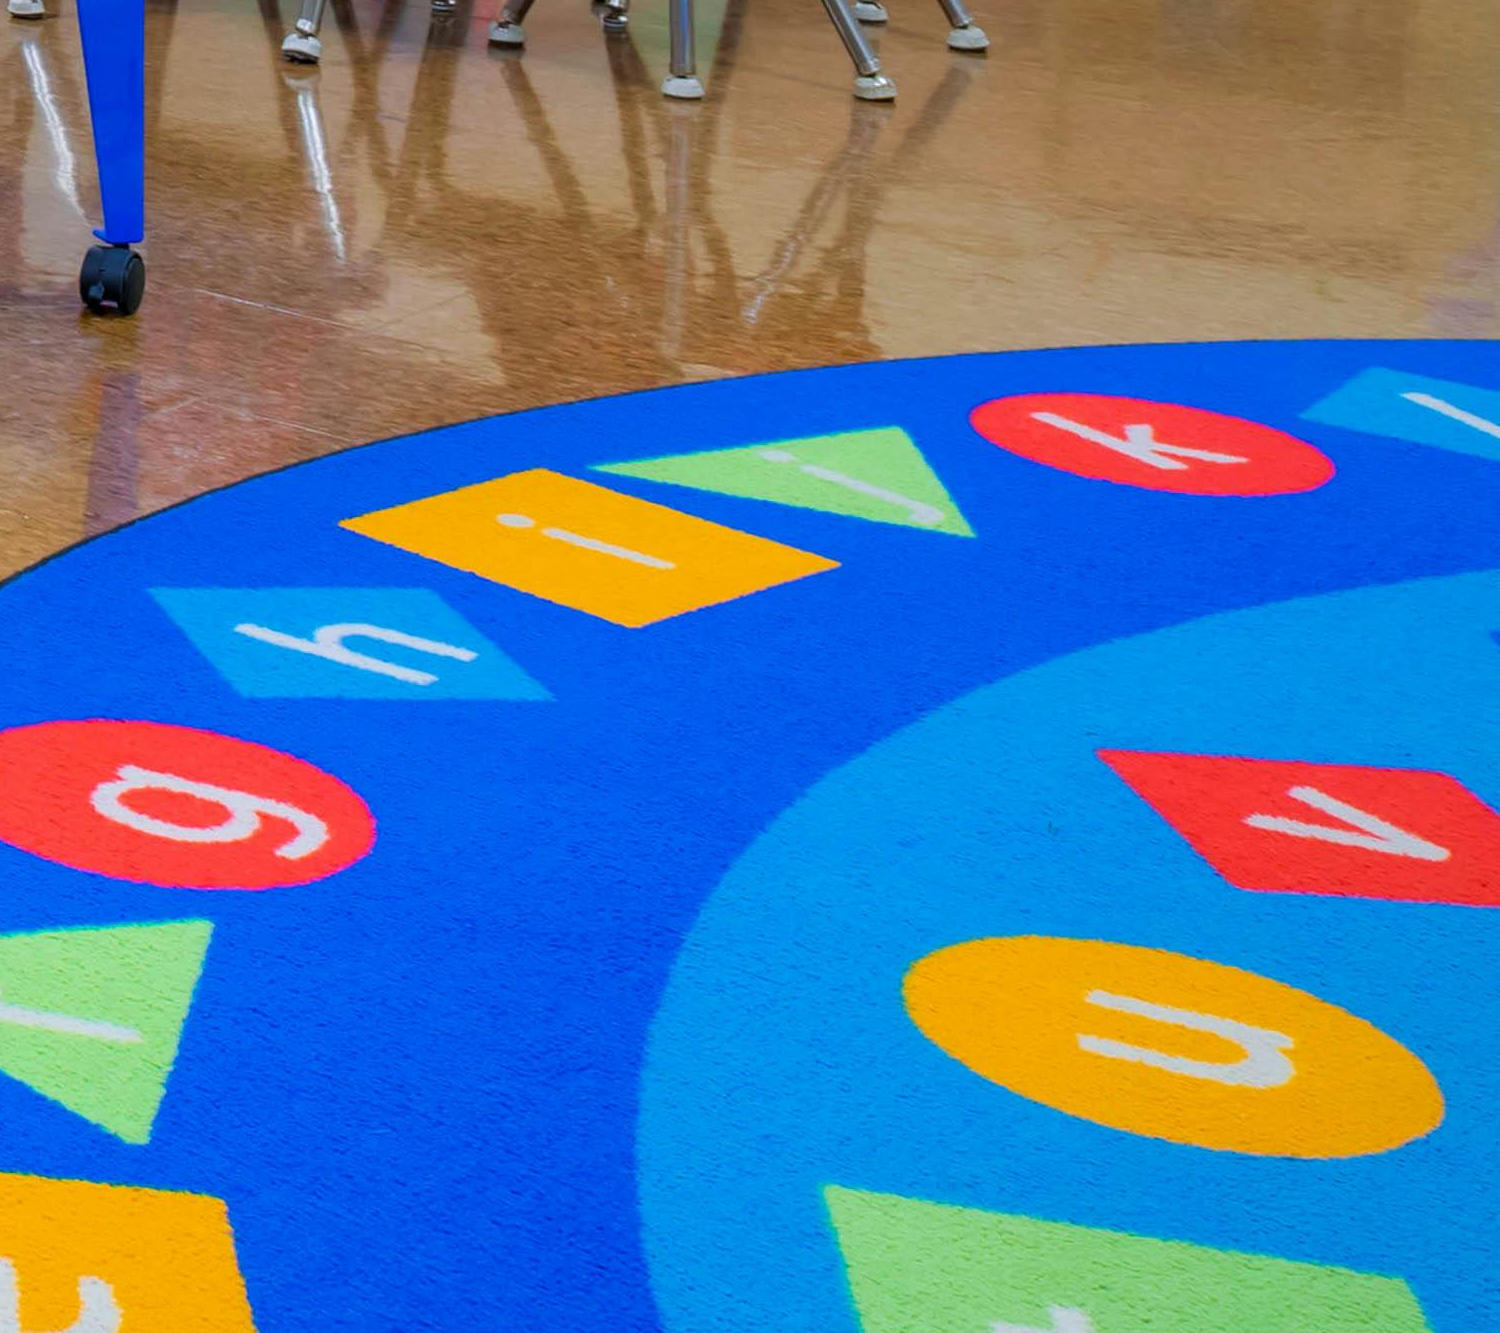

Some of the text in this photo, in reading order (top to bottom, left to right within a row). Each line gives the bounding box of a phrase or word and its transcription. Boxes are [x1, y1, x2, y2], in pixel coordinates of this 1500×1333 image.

[1029, 410, 1250, 471] k
[758, 448, 946, 526] j
[496, 512, 673, 570] i
[234, 620, 478, 687] h
[89, 763, 330, 861] g
[1242, 785, 1448, 863] v
[1076, 987, 1297, 1090] u
